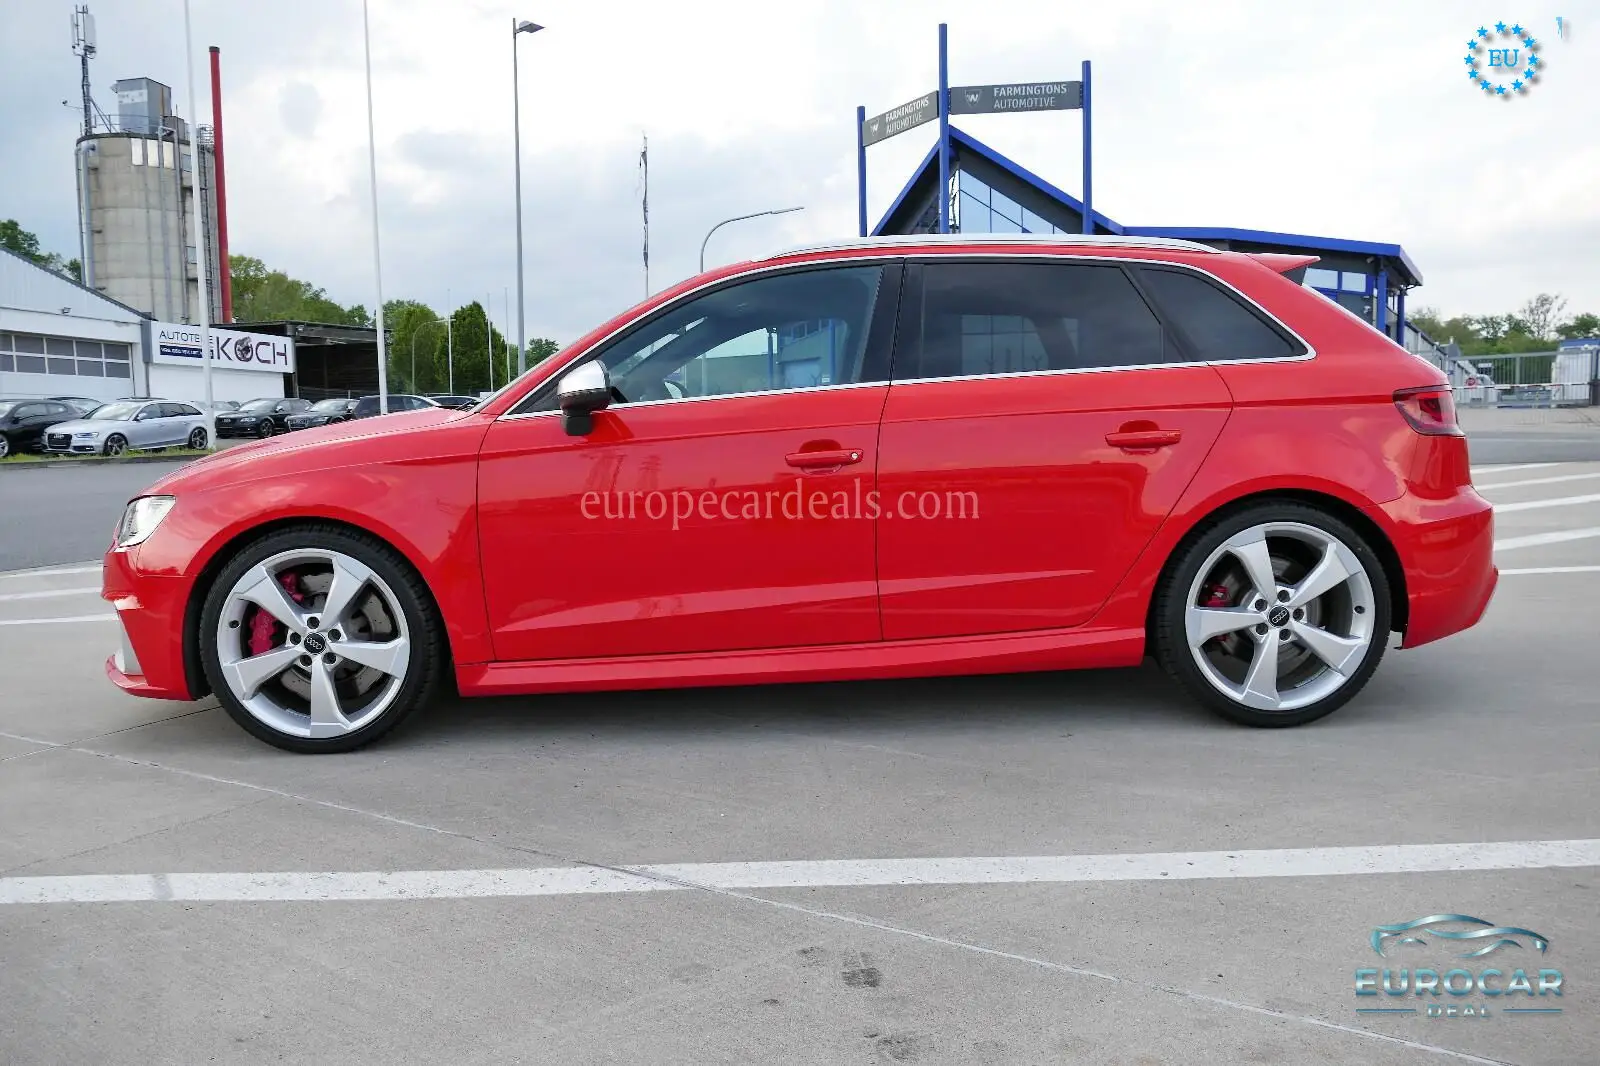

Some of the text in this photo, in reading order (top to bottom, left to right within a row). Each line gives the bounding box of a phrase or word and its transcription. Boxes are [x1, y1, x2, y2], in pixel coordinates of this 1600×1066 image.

[993, 83, 1068, 97] FARMINGTONS
[885, 96, 929, 123] FARMINGTONS
[993, 96, 1055, 109] AUTOMOTIVE
[885, 112, 923, 136] AUTOMOTIVE
[215, 335, 288, 366] KOCH
